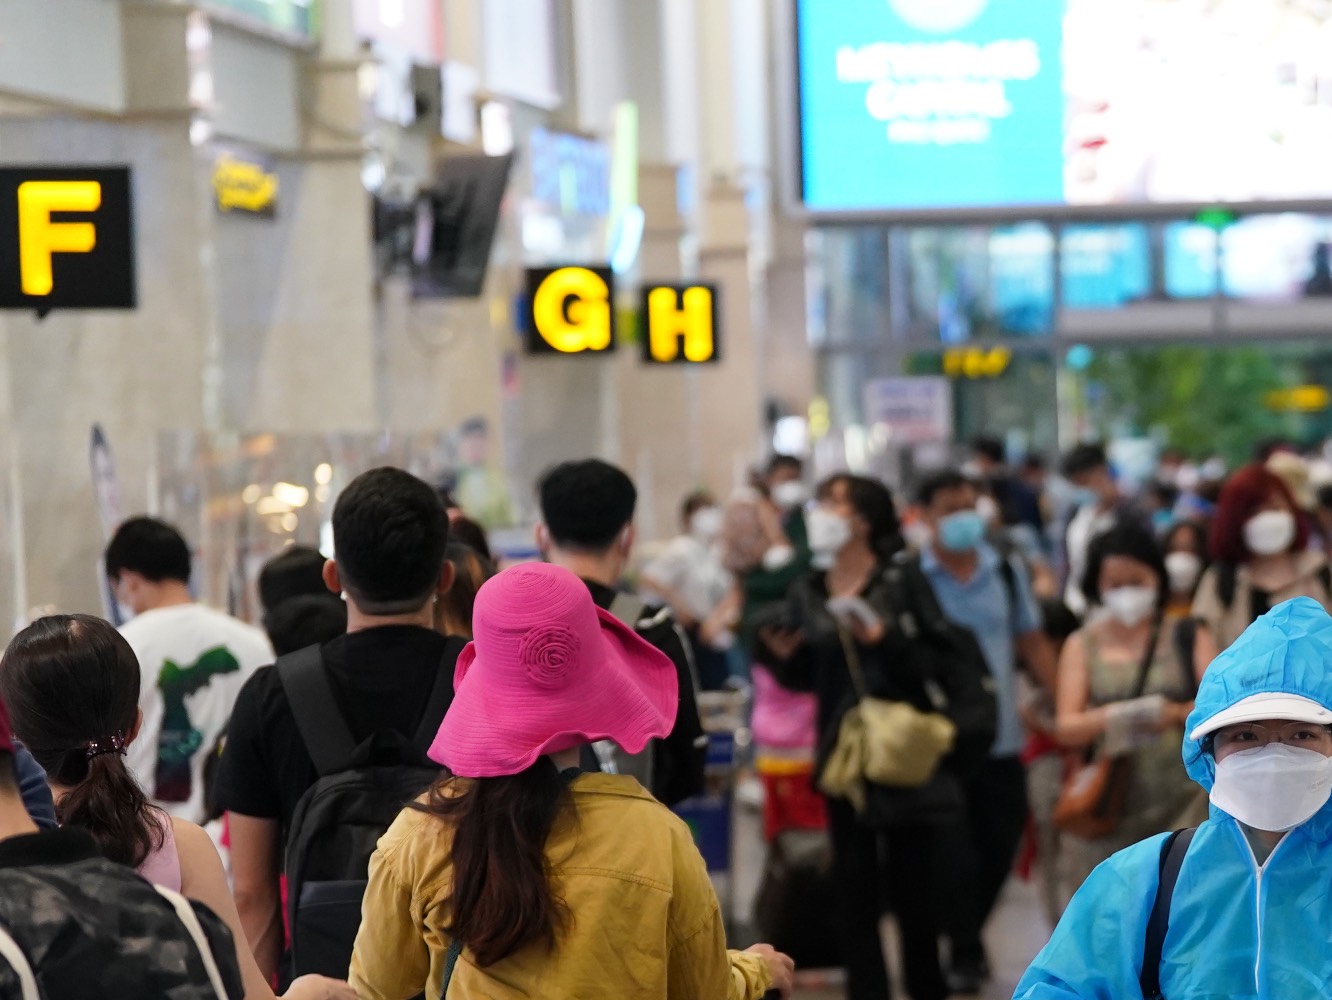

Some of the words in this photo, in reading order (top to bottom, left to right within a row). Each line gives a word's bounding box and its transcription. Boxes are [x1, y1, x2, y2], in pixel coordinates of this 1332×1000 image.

[17, 180, 102, 296] F
[534, 266, 612, 353] G
[649, 285, 714, 362] H
